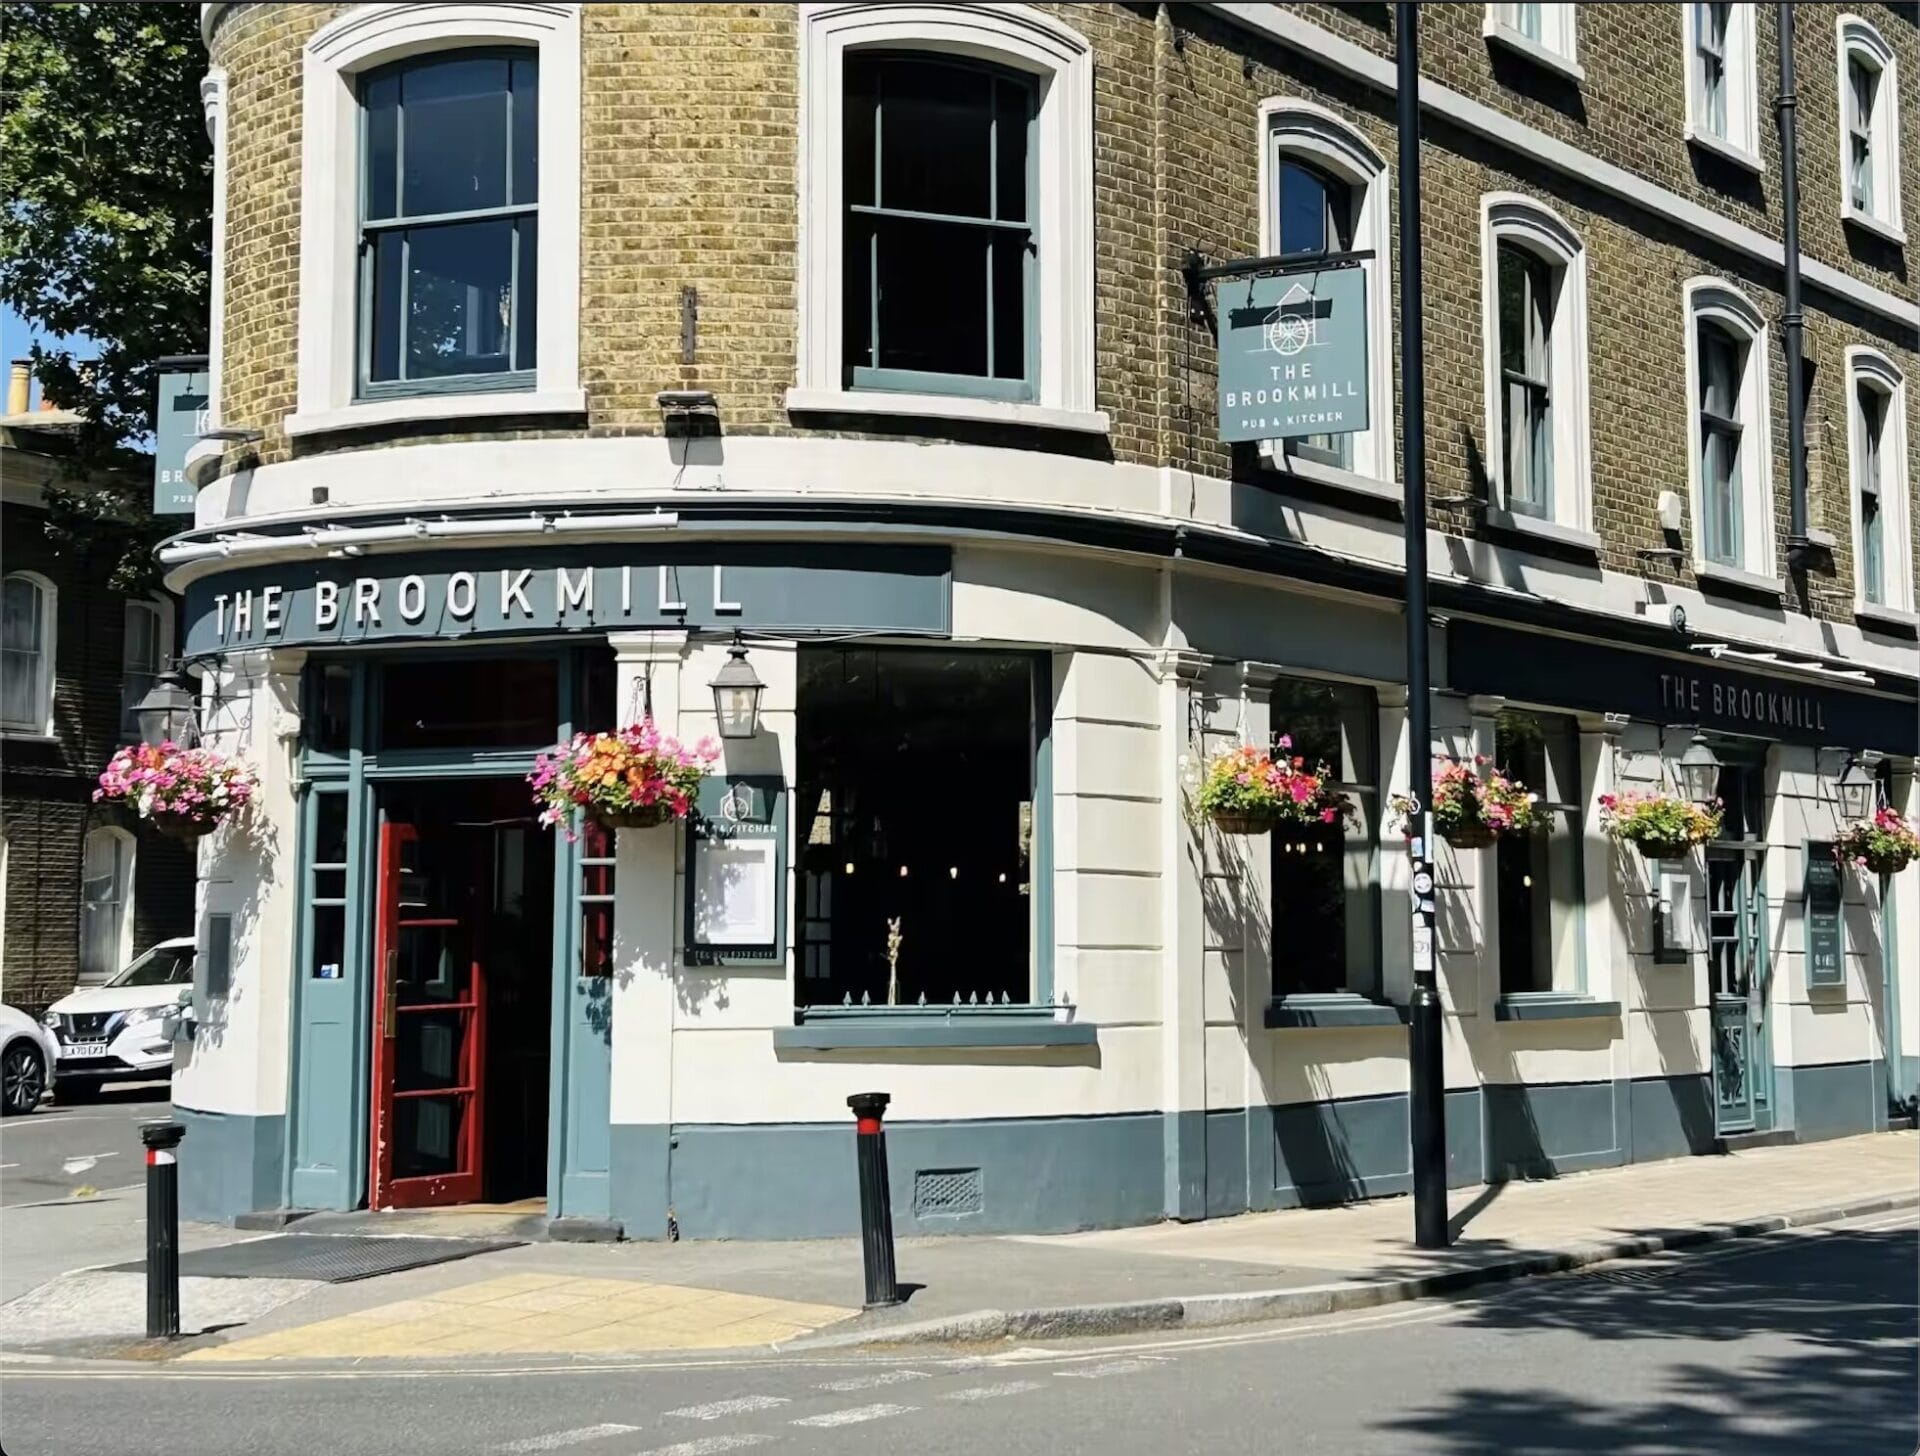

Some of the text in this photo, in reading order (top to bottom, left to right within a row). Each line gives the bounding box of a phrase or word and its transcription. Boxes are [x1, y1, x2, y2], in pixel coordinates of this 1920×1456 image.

[1270, 363, 1313, 381] THE
[1226, 381, 1358, 407] BROOKMILL
[1241, 411, 1343, 429] PUB & KITCHEN
[214, 565, 742, 636] THE BROOKMILL
[1661, 674, 1825, 731] THE BROOKMILL
